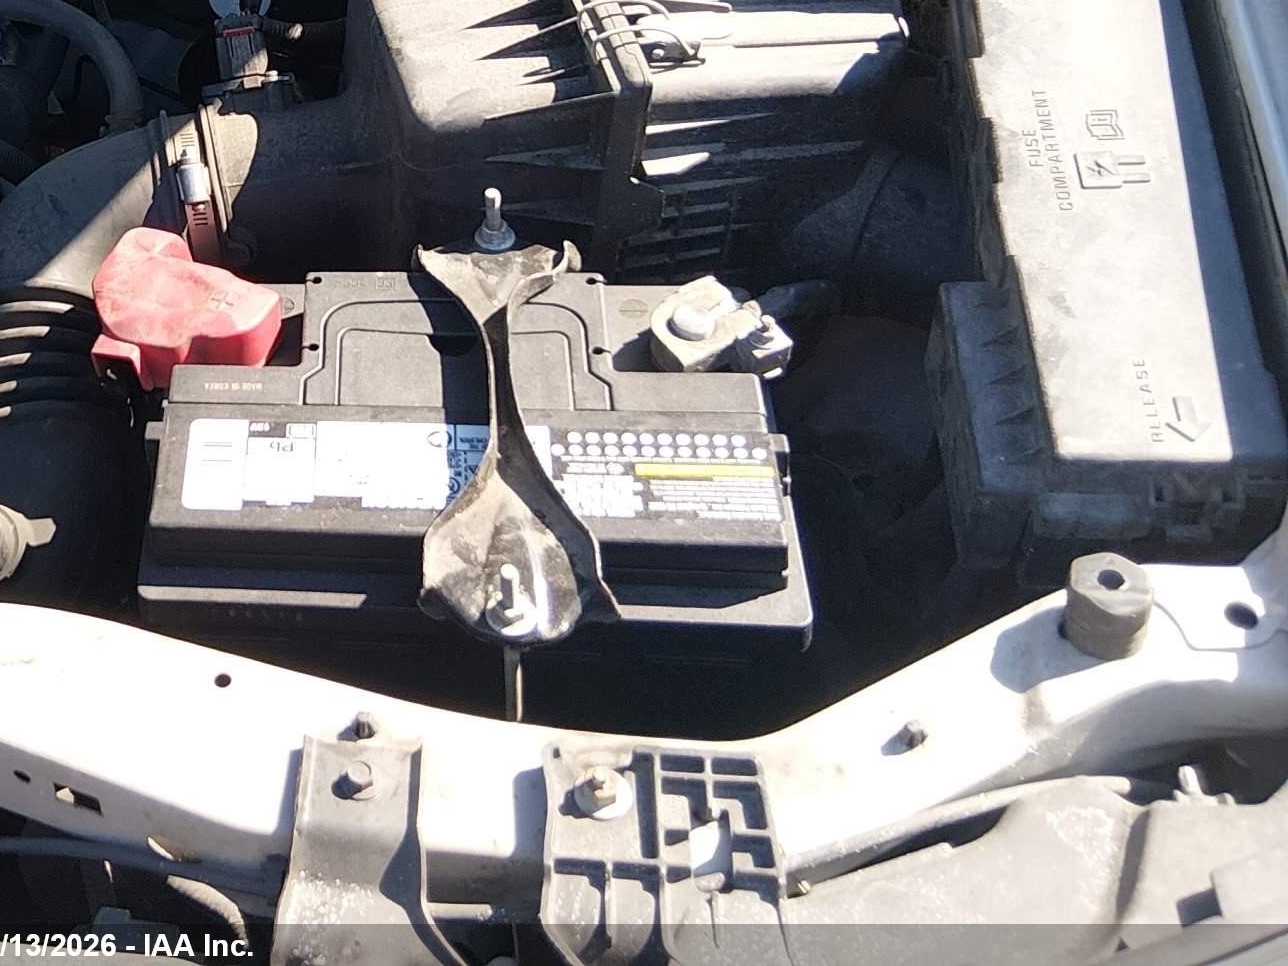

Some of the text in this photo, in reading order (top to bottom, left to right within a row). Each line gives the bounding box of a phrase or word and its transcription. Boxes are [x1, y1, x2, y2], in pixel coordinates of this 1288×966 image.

[1022, 130, 1044, 167] FUSE
[1032, 90, 1073, 210] COMPARTMENT
[1133, 359, 1165, 443] RELEASE
[270, 441, 294, 453] Pb
